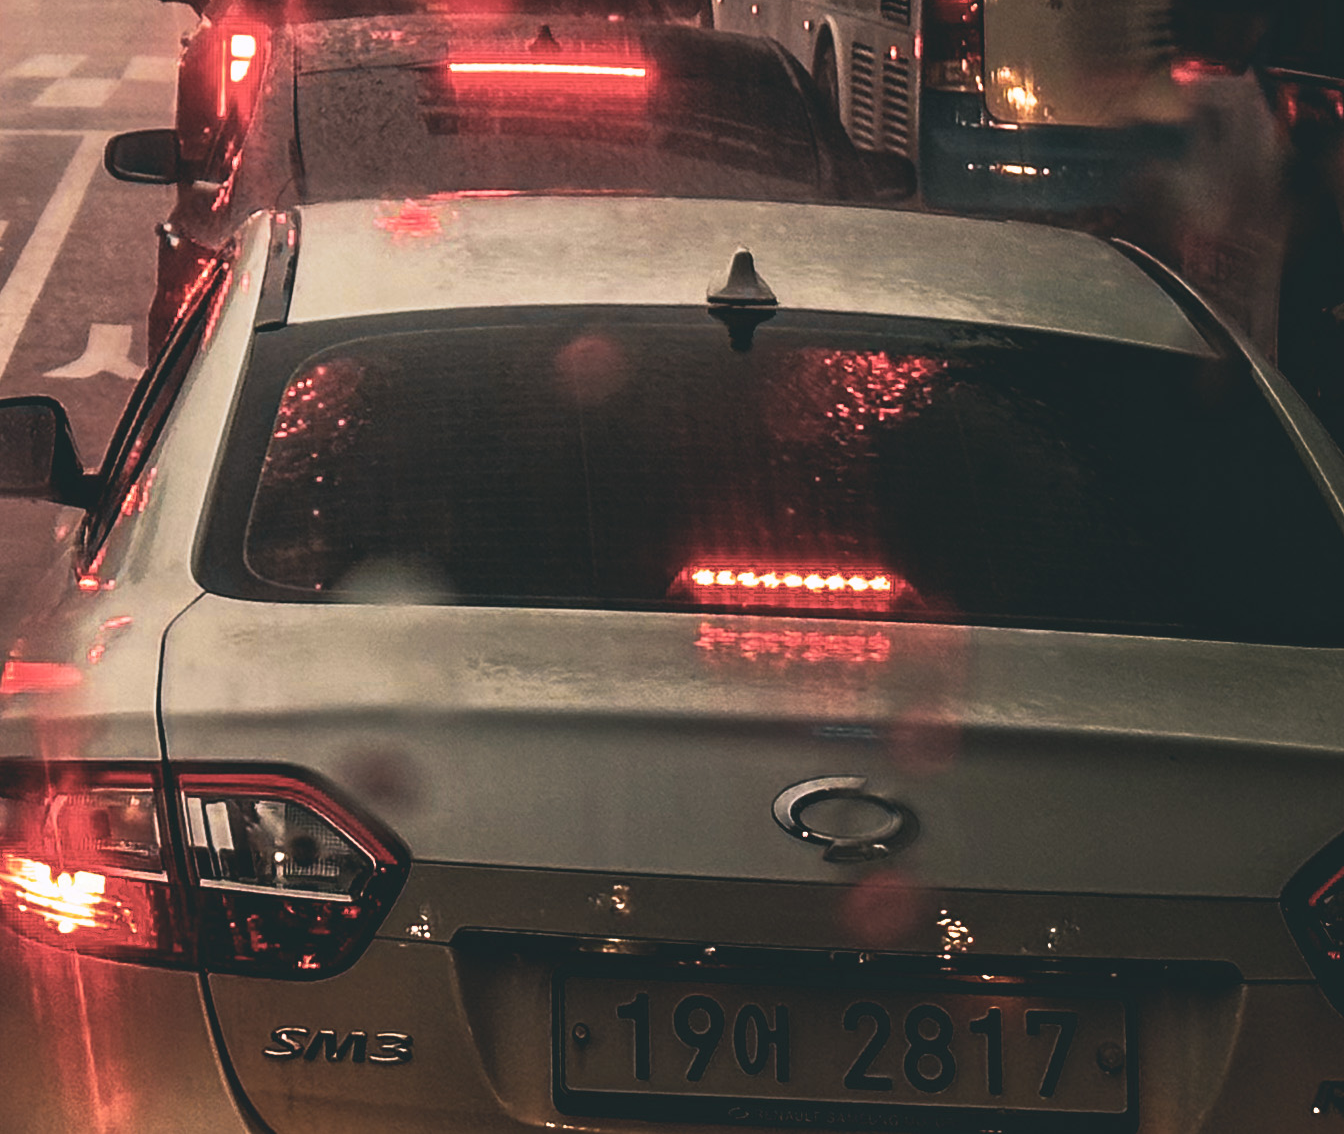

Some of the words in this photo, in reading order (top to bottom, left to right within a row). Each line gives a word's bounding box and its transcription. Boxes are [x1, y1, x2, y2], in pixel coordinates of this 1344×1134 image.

[262, 1025, 414, 1065] SM3
[616, 991, 791, 1085] 19어
[842, 1001, 1080, 1100] 2817
